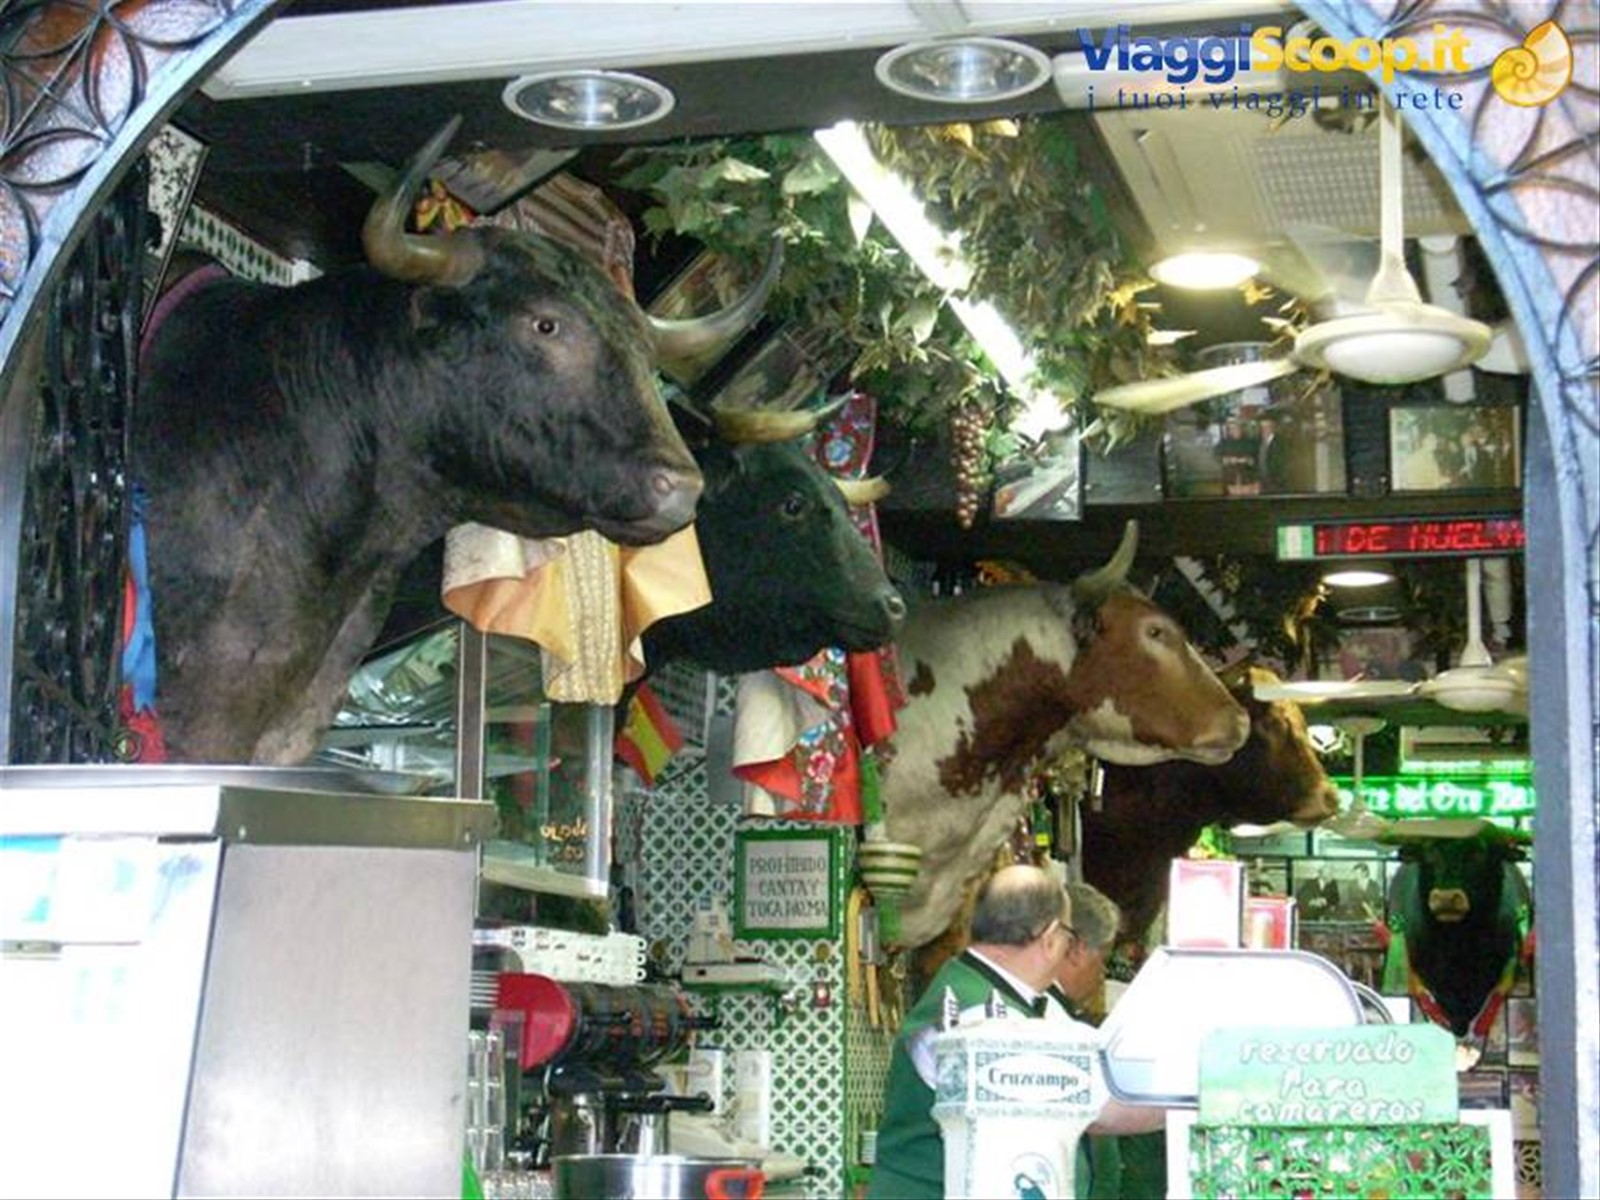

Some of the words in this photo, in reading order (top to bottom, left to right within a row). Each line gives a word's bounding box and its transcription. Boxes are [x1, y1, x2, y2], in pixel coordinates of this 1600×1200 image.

[1346, 524, 1393, 552] DE
[988, 1067, 1080, 1090] Cruzcampo
[1237, 1098, 1426, 1124] camareros
